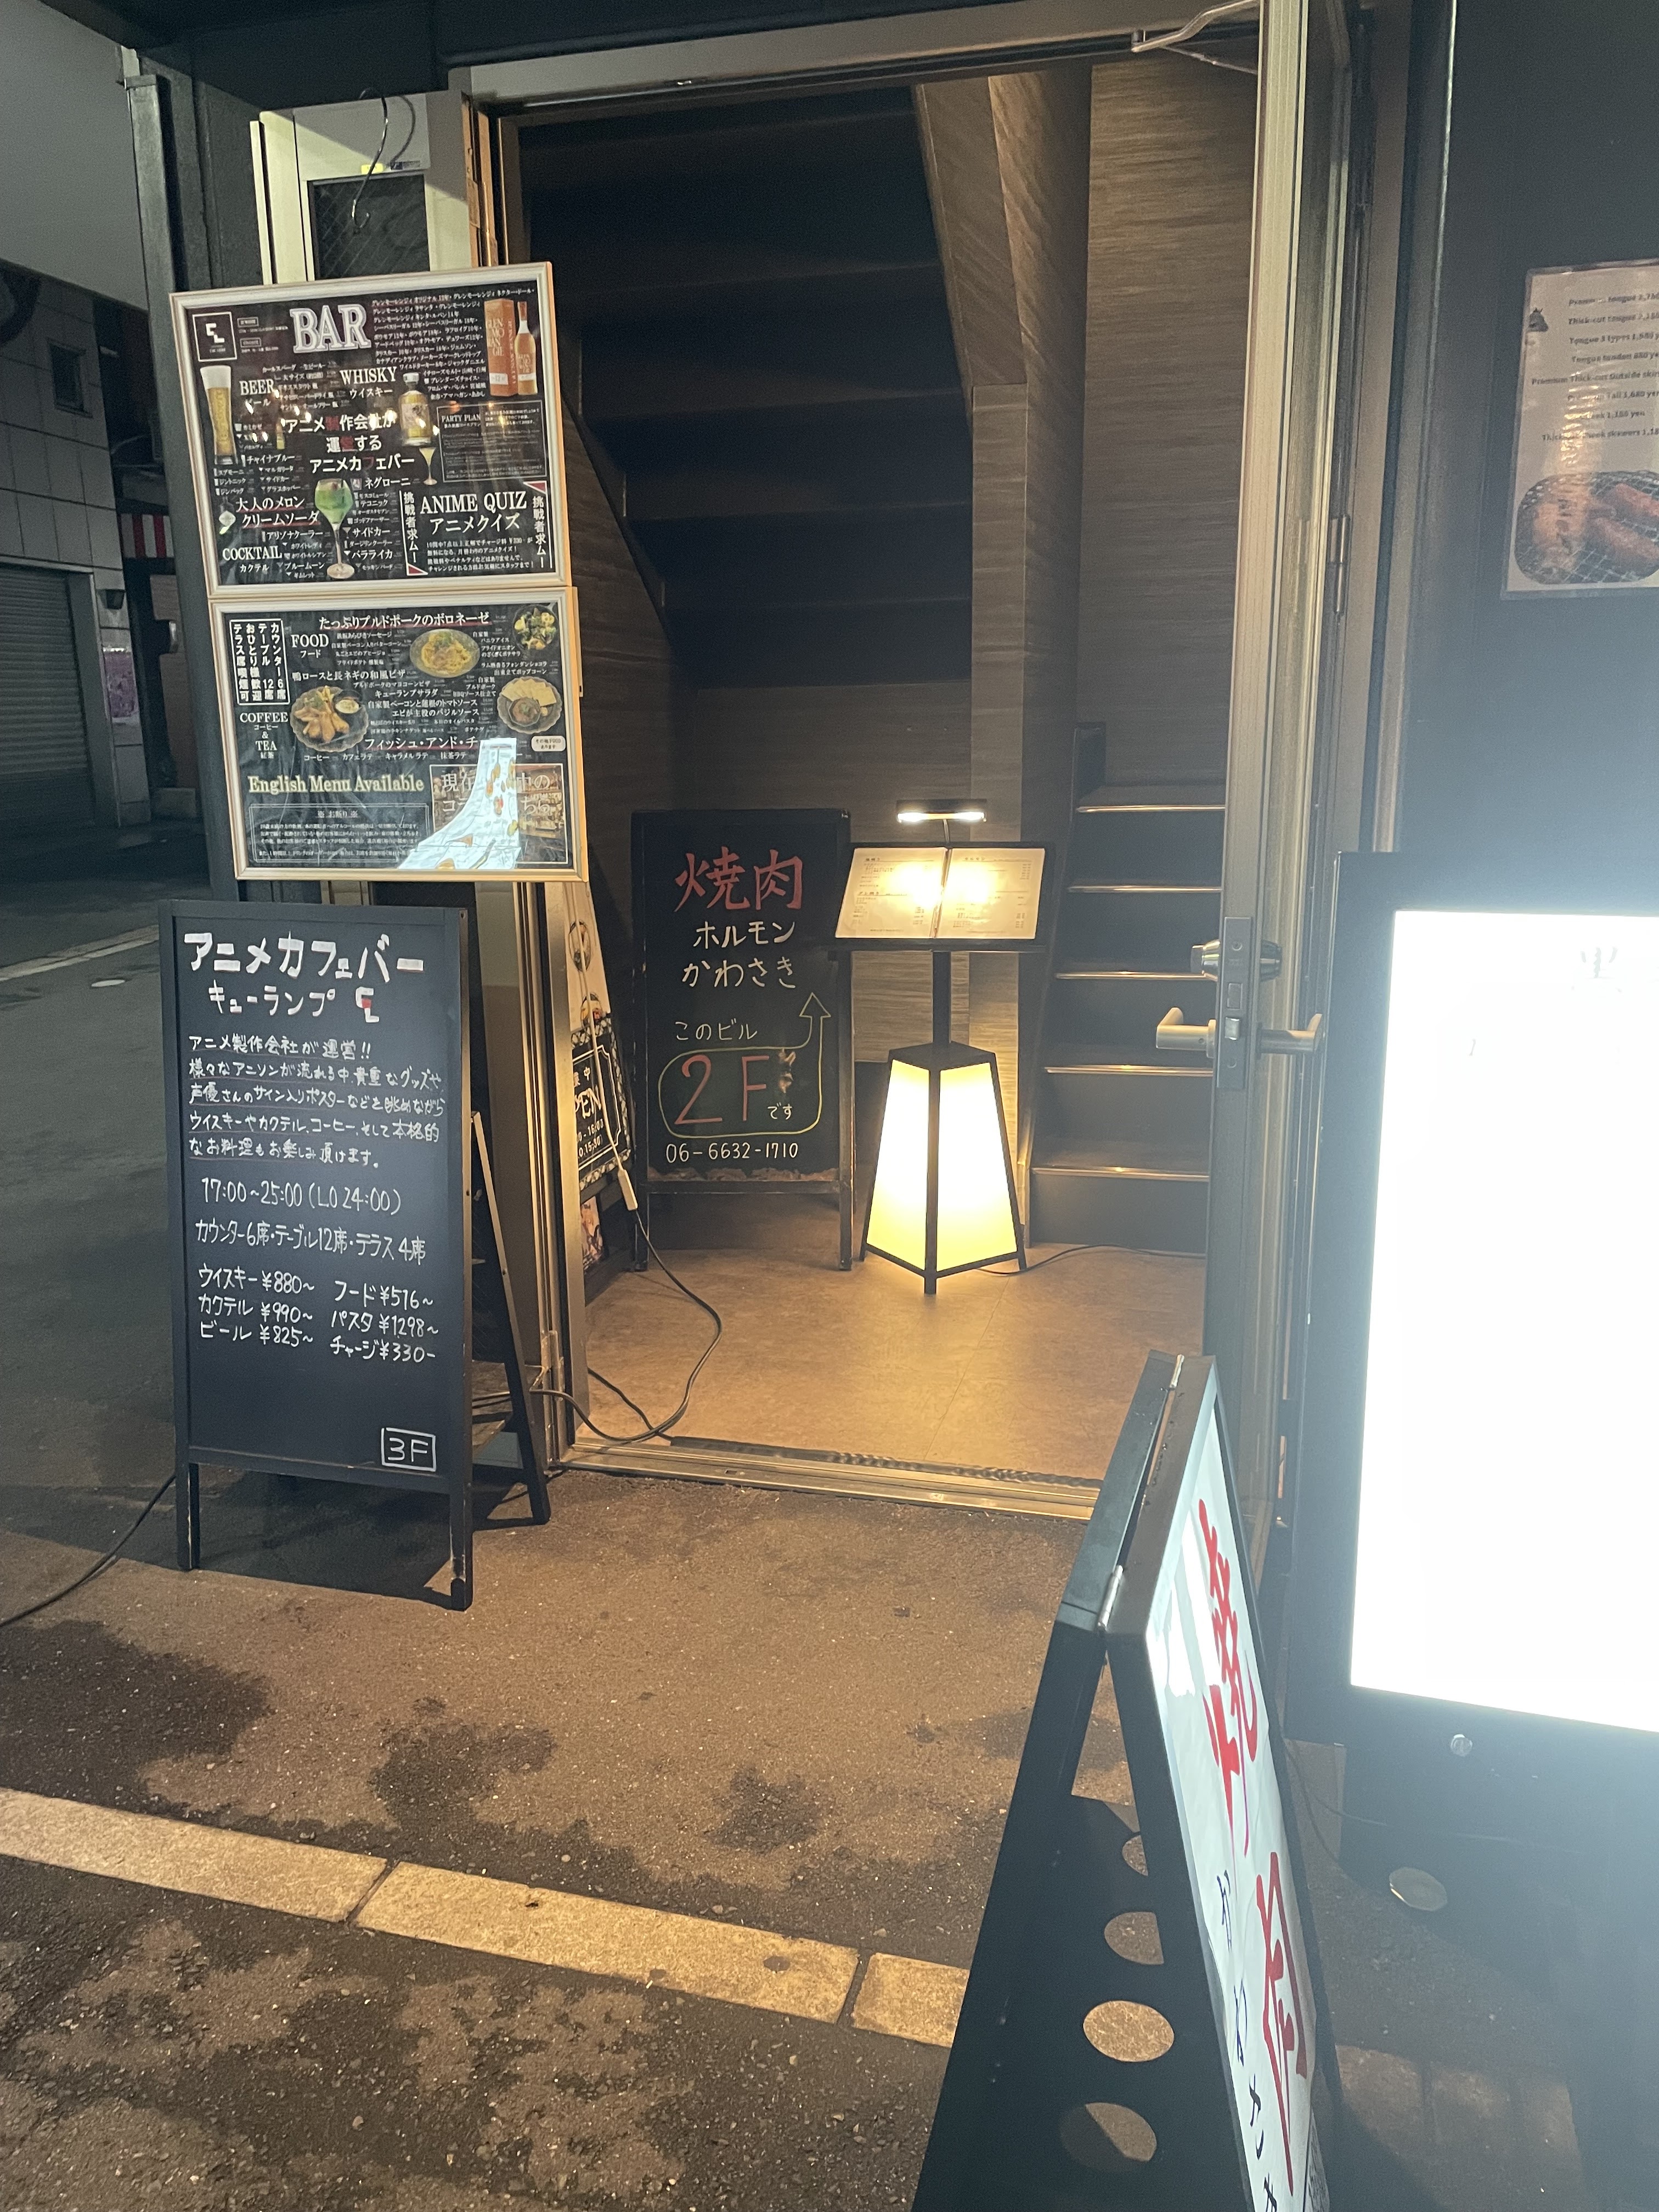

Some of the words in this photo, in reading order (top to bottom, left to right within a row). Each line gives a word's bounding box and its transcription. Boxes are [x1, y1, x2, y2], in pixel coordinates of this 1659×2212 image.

[290, 304, 372, 353] BAR
[340, 366, 398, 385] WHISKY
[239, 379, 274, 396] BEER
[349, 386, 393, 399] ウイスキー
[247, 454, 295, 465] チャイナブルー
[310, 453, 415, 473] アニメカフェバー
[364, 476, 411, 489] ネグローニ
[236, 495, 305, 512] 大人のメロン
[420, 494, 478, 515] ANIME
[483, 490, 527, 514] QUIZ
[242, 510, 320, 528] クリームソーダ
[430, 512, 521, 535] アニメクイズ
[352, 526, 391, 538] サイドカー
[222, 545, 283, 561] COCKTAIL
[351, 549, 393, 560] バラライカ
[240, 563, 269, 574] カクテル
[258, 623, 270, 666] テーブル
[290, 633, 330, 648] FOOD
[300, 649, 321, 659] フード
[240, 712, 289, 723] COFFEE
[255, 740, 278, 751] TEA
[262, 731, 269, 739] &
[247, 774, 308, 795] English
[308, 775, 352, 793] Menu
[354, 773, 425, 793] Available
[674, 846, 803, 912] 焼肉
[693, 921, 795, 949] ホルモン
[184, 931, 425, 983] アニメカフェバー
[682, 956, 797, 989] かわさき
[208, 979, 336, 1017] キューランプ
[674, 1018, 758, 1041] このビル
[674, 1055, 771, 1125] 2F
[767, 1102, 793, 1120] です
[665, 1142, 799, 1164] 06-6632-1710
[199, 1262, 258, 1289] ウイスキー
[334, 1280, 377, 1307] フード
[198, 1293, 254, 1317] カクテル
[200, 1321, 252, 1341] ビール
[331, 1310, 374, 1333] パスタ
[330, 1335, 379, 1360] チャージ
[388, 1437, 428, 1463] 3F
